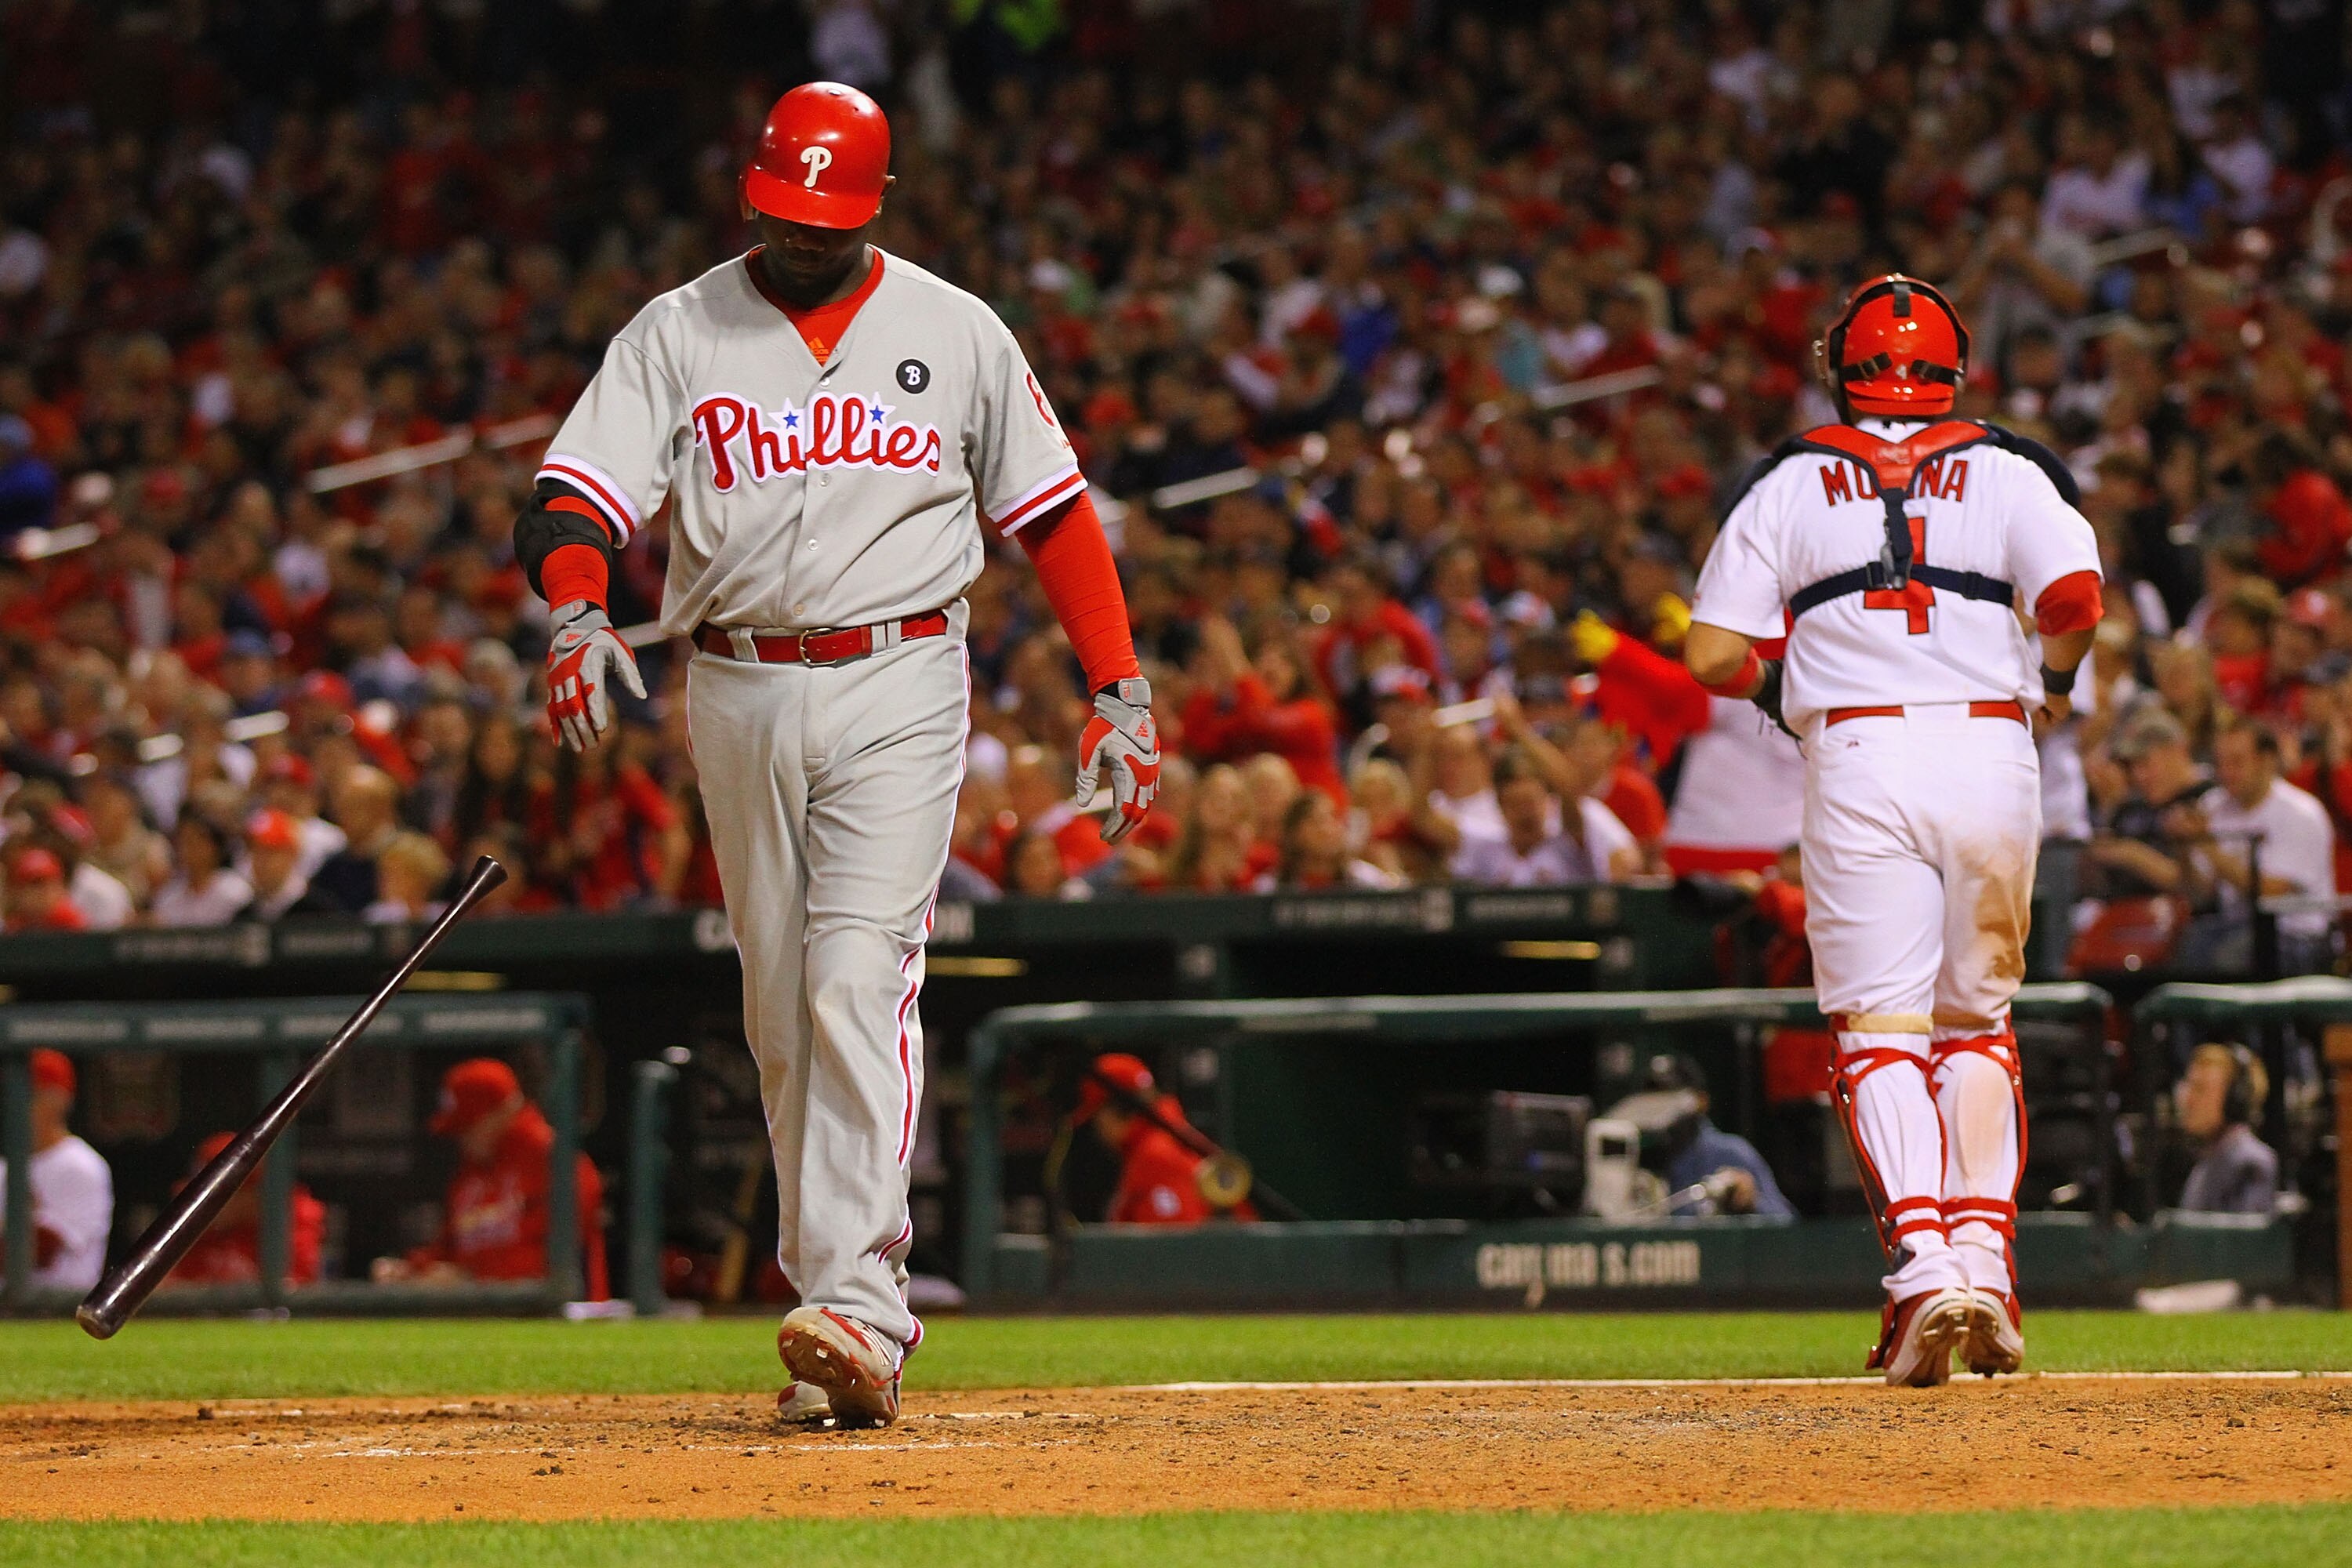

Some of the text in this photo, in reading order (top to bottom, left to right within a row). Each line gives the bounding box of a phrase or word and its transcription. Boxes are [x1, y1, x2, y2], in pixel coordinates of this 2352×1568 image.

[800, 146, 833, 188] P
[905, 365, 921, 386] B
[691, 395, 941, 490] Phillies
[1819, 457, 1969, 507] MONA
[1864, 517, 1936, 635] 4
